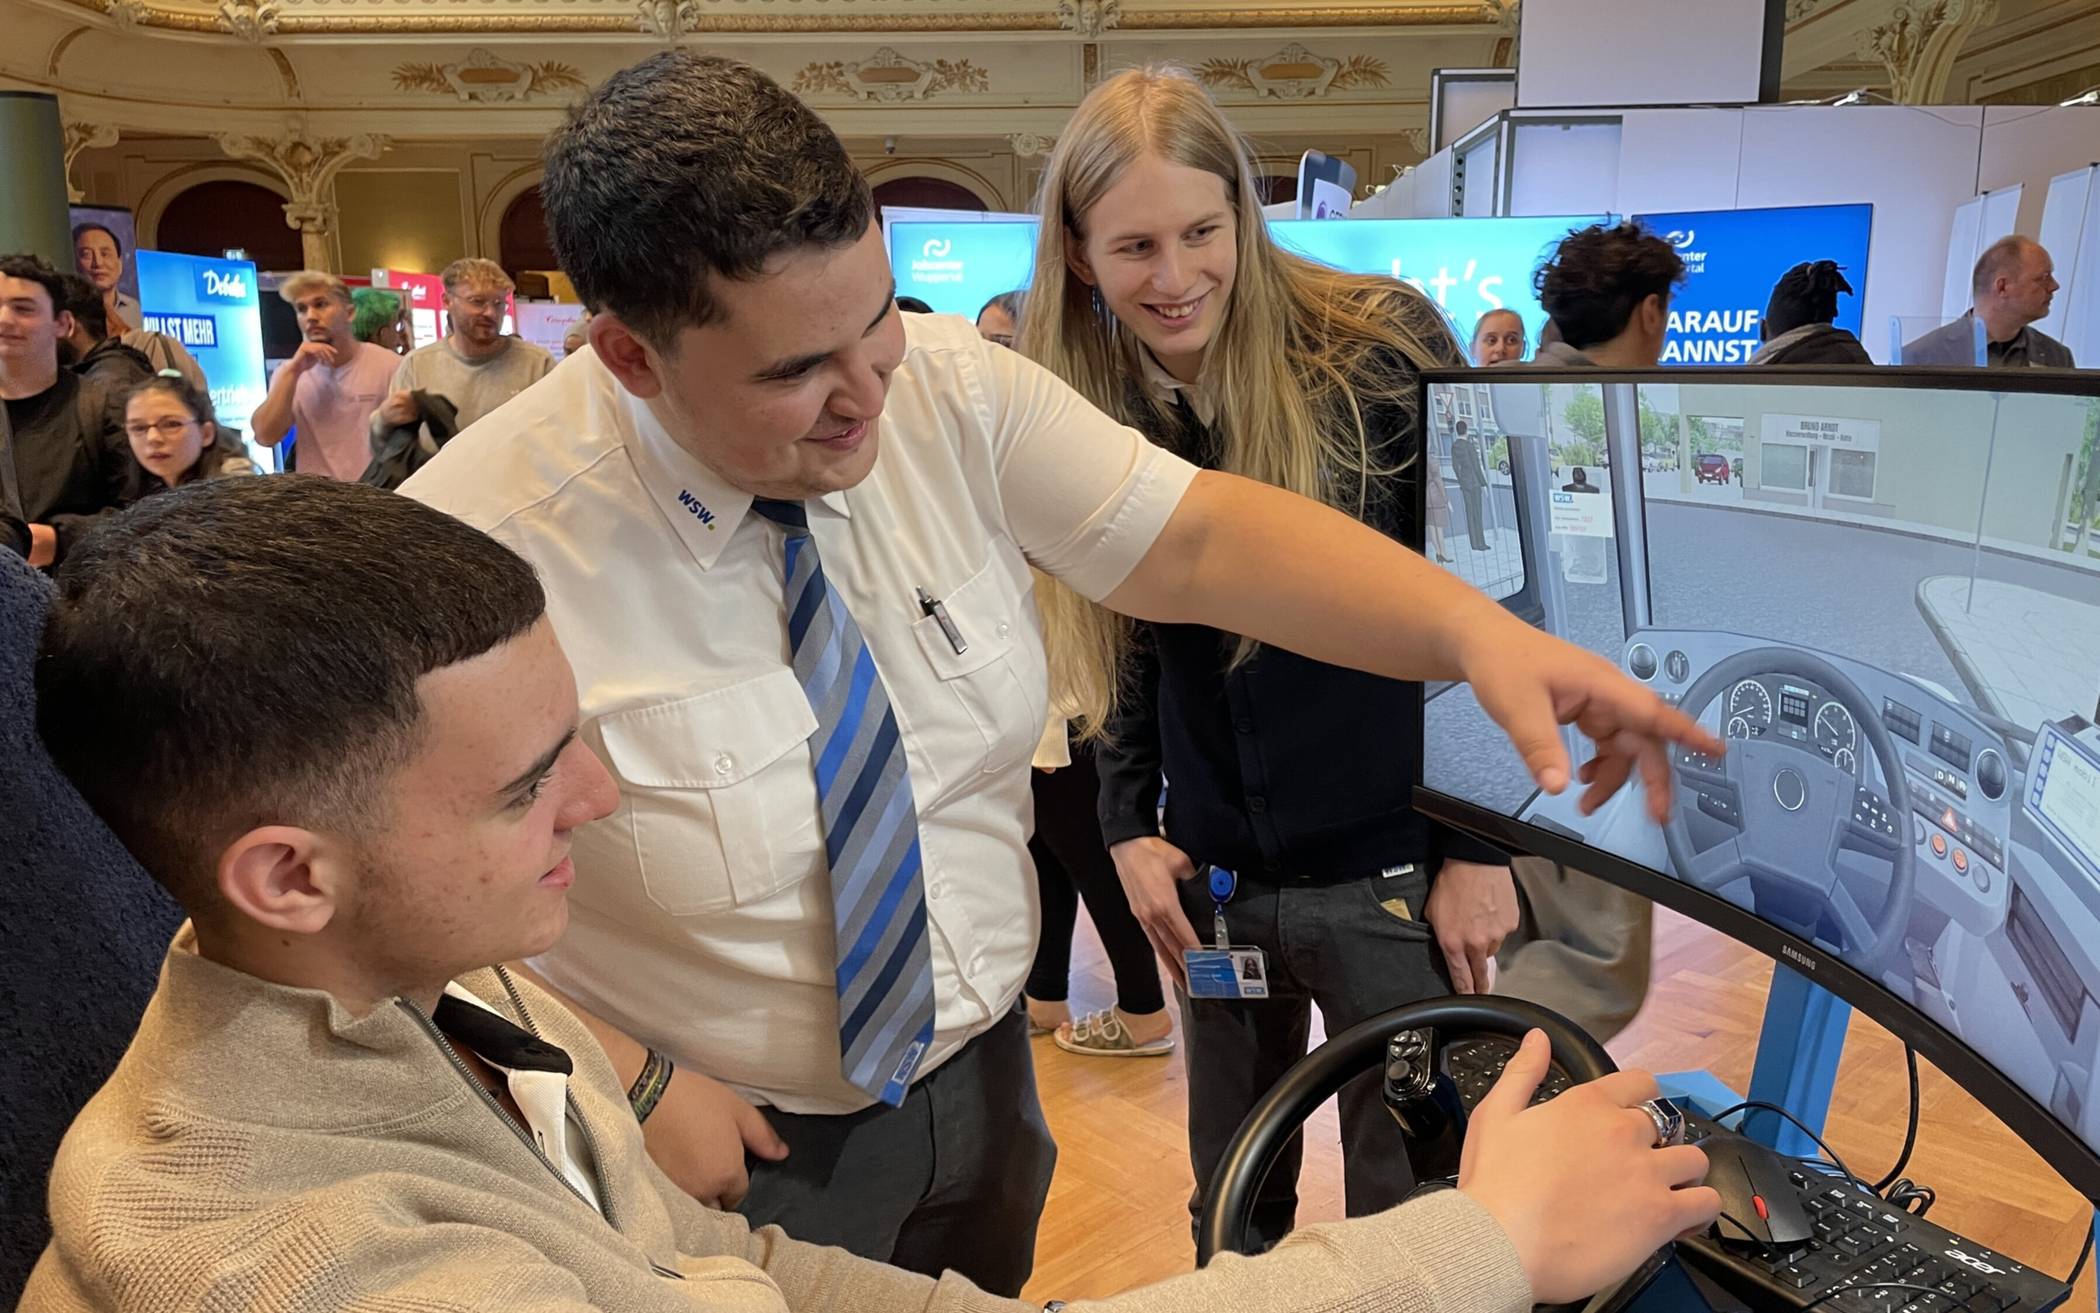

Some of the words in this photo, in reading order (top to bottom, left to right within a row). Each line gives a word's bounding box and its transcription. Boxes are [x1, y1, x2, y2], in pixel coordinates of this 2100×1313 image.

[1681, 251, 1707, 262] nter
[183, 317, 215, 346] MEHR
[1666, 310, 1759, 333] ARAUF
[1658, 339, 1758, 363] ANNST
[1782, 944, 1816, 970] SAMSUNG
[1944, 1248, 2007, 1275] acer
